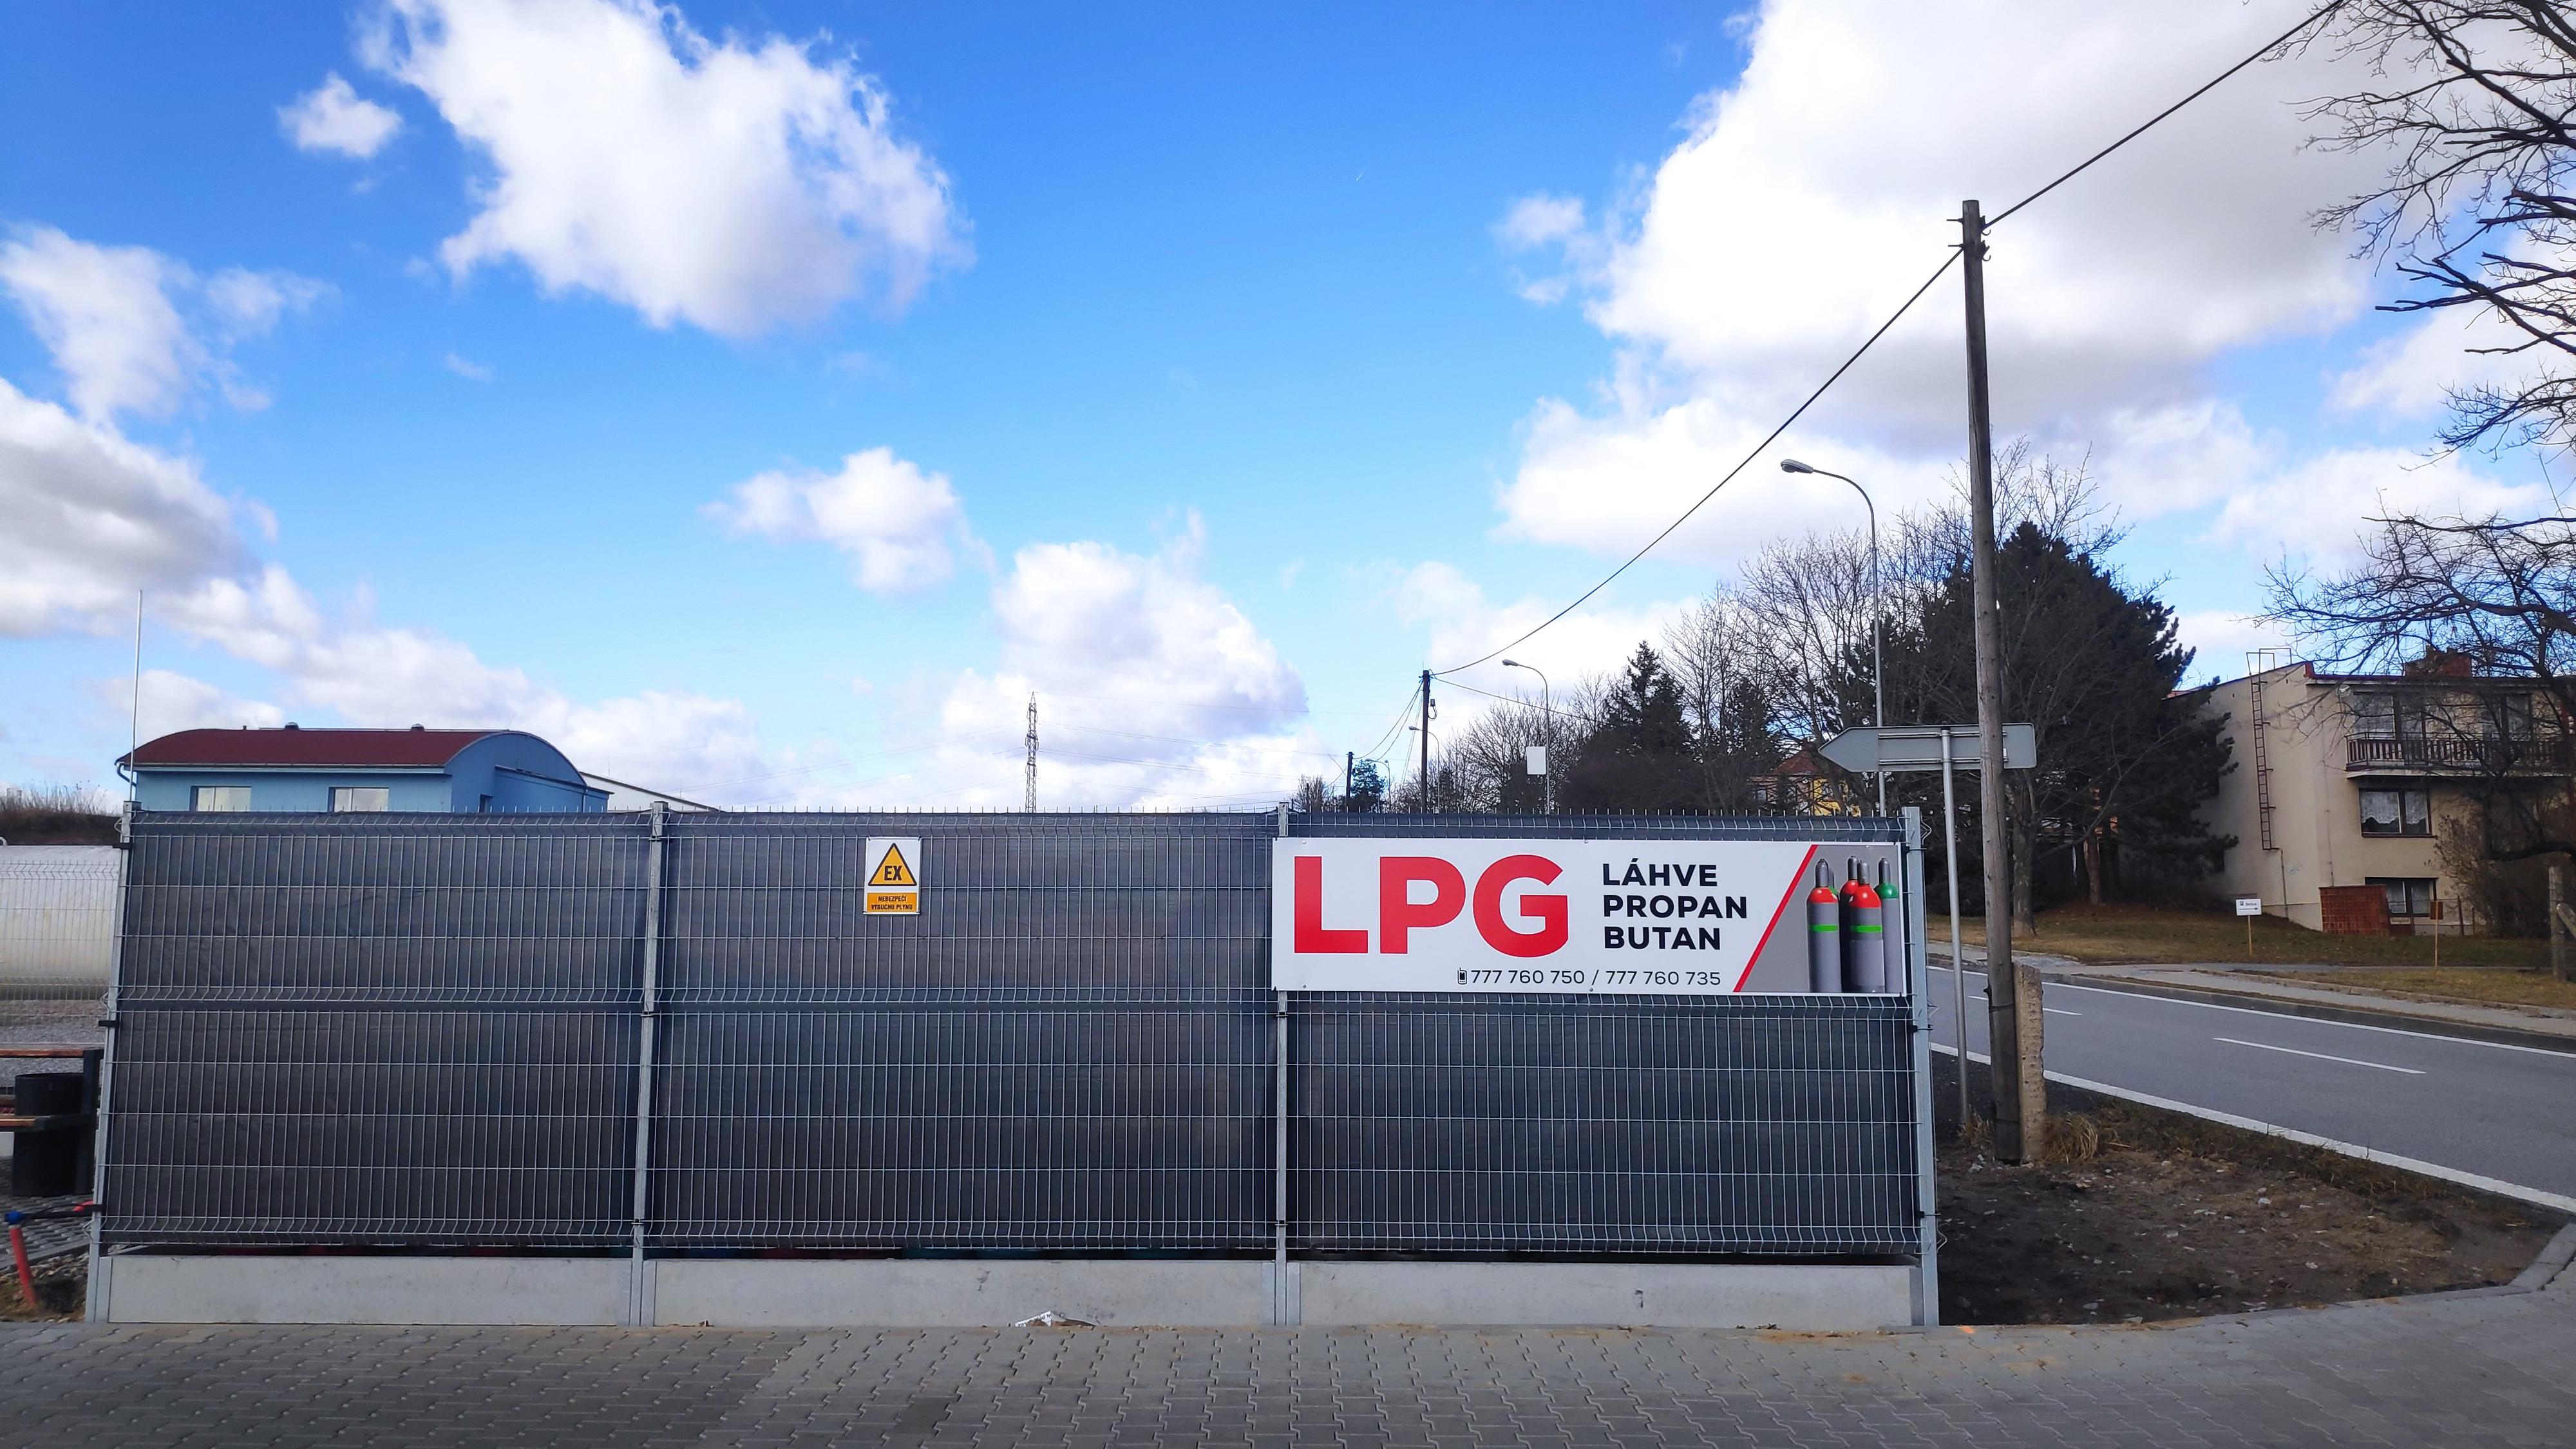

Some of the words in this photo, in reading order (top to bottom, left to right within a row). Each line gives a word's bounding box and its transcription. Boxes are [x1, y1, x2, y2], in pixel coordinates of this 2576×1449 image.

[884, 865, 903, 881] EX
[1602, 857, 1718, 887] LÁHVE
[1294, 854, 1569, 958] LPG
[1603, 895, 1747, 919] PROPAN
[1604, 926, 1721, 951] BUTAN
[1470, 970, 1502, 984] 777
[1508, 970, 1544, 984] 760
[1550, 971, 1585, 984] 750
[1591, 969, 1600, 985] /
[1605, 971, 1638, 985] 777
[1643, 971, 1680, 985] 760
[1685, 971, 1721, 985] 735
